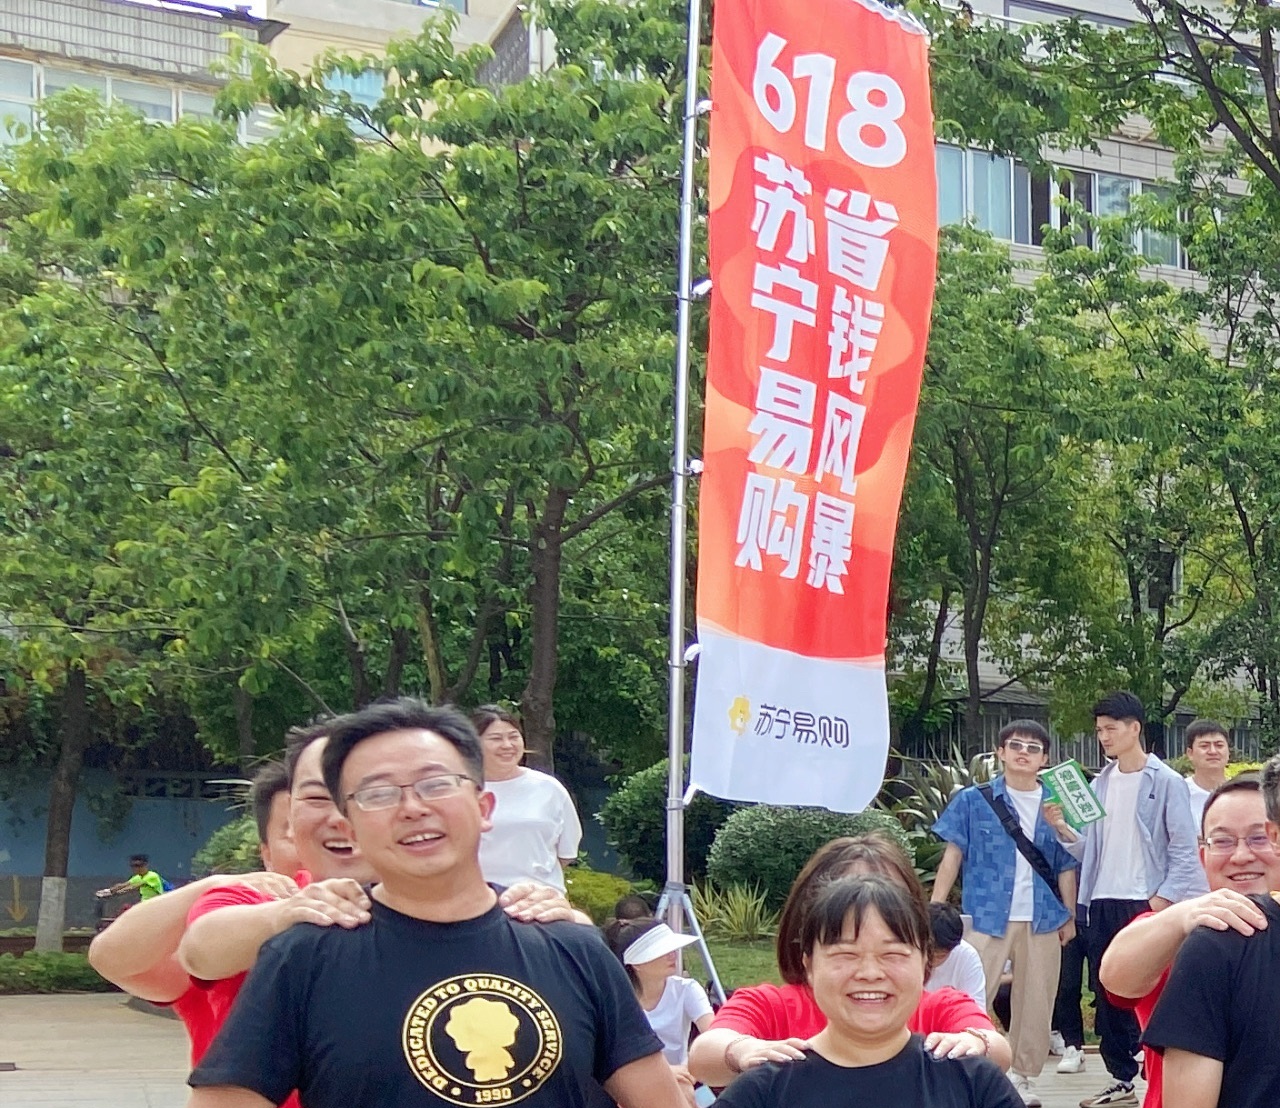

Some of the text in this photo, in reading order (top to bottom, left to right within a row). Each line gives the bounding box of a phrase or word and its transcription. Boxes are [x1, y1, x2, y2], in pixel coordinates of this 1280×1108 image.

[753, 32, 908, 168] 618
[734, 151, 819, 580] 苏宁易购
[805, 188, 900, 595] 省钱风暴
[753, 702, 851, 749] 苏宁易购
[409, 978, 558, 1091] DEDICATED TO QUALITY SERVICE
[475, 1087, 512, 1103] 1990
